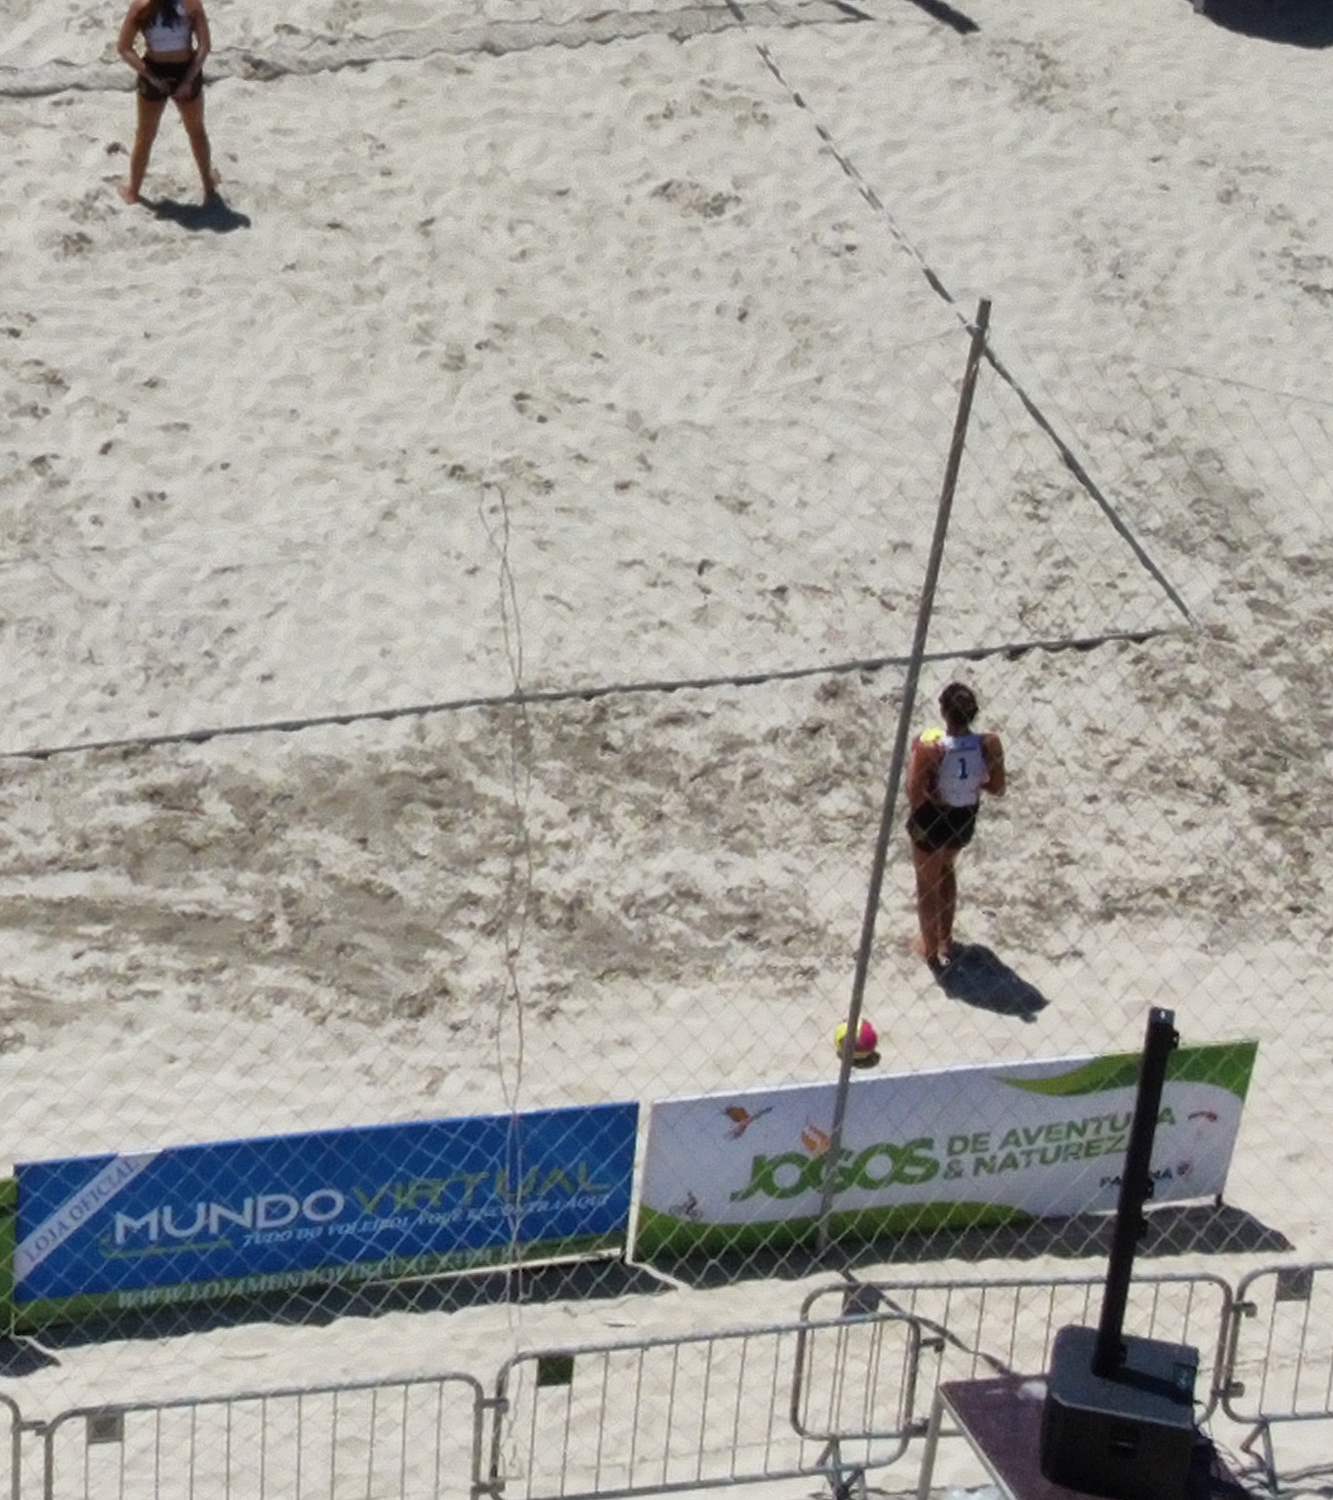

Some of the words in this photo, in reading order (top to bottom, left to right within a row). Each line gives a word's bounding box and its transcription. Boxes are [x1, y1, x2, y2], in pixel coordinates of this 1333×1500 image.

[958, 757, 969, 780] 1
[942, 1157, 964, 1181] &
[972, 1134, 1129, 1178] NATUREZ
[946, 1131, 991, 1157] DE
[997, 1106, 1176, 1151] AVENTUA
[730, 1137, 941, 1202] JOGOS
[23, 1222, 70, 1264] LOJA
[69, 1158, 141, 1224] OFICIAL
[114, 1188, 345, 1245] MUNDO
[351, 1160, 613, 1215] VIRTUAL
